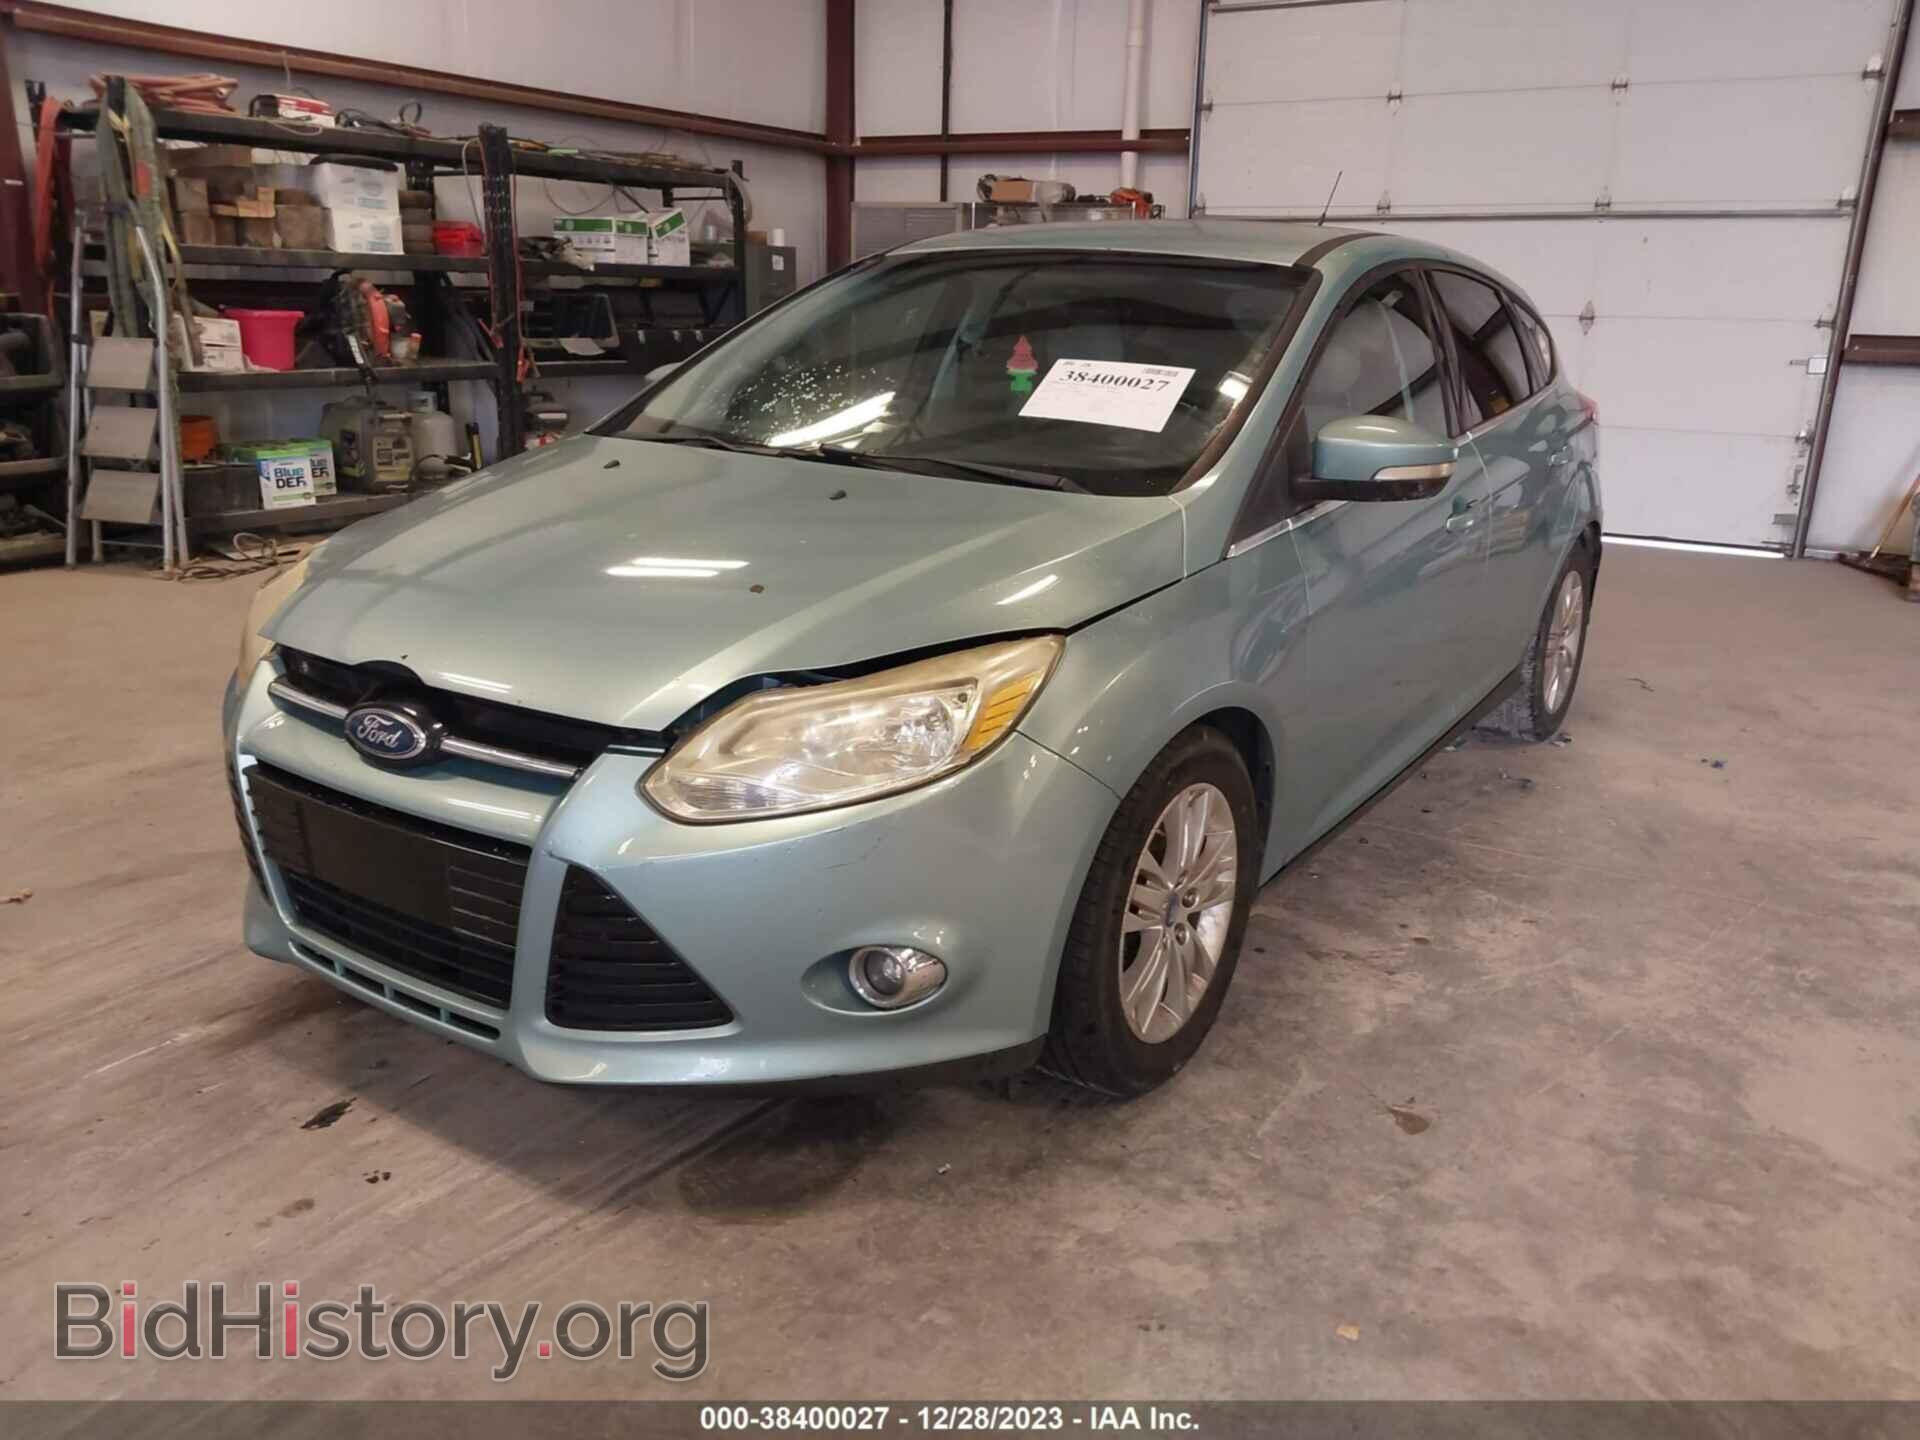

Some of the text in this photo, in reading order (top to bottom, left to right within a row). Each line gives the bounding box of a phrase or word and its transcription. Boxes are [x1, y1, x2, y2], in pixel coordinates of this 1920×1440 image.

[1058, 369, 1172, 392] 38400027
[273, 467, 305, 478] Blue
[356, 714, 403, 748] Ford
